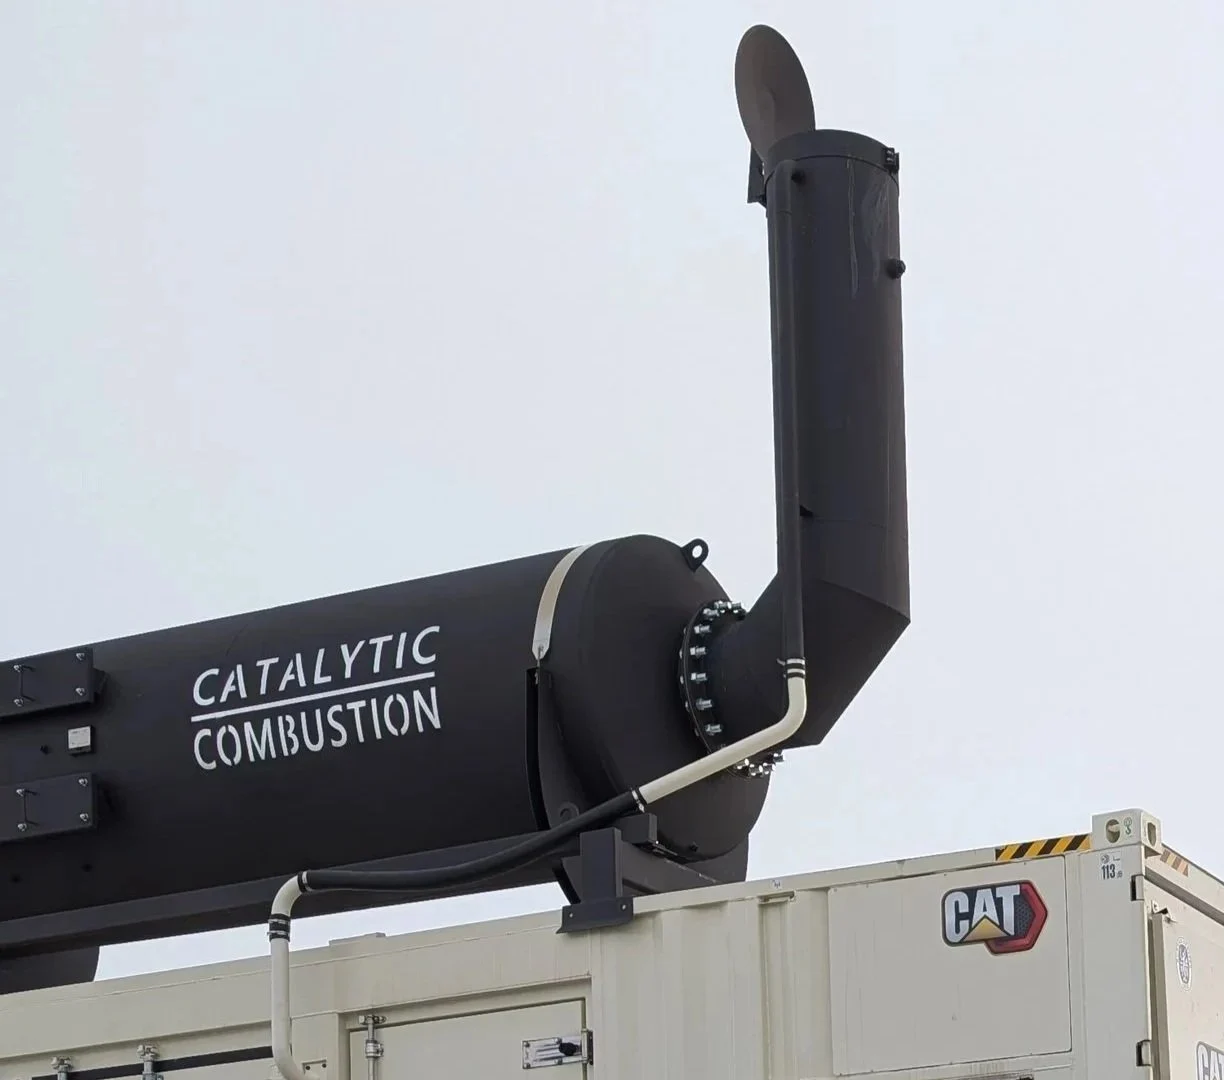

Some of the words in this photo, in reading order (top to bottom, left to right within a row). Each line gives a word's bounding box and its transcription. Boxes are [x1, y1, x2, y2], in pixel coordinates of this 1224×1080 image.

[193, 626, 440, 706] CATALYTIC
[194, 687, 441, 770] COMBUSTION
[1101, 864, 1116, 880] 113
[944, 884, 1020, 943] CAT
